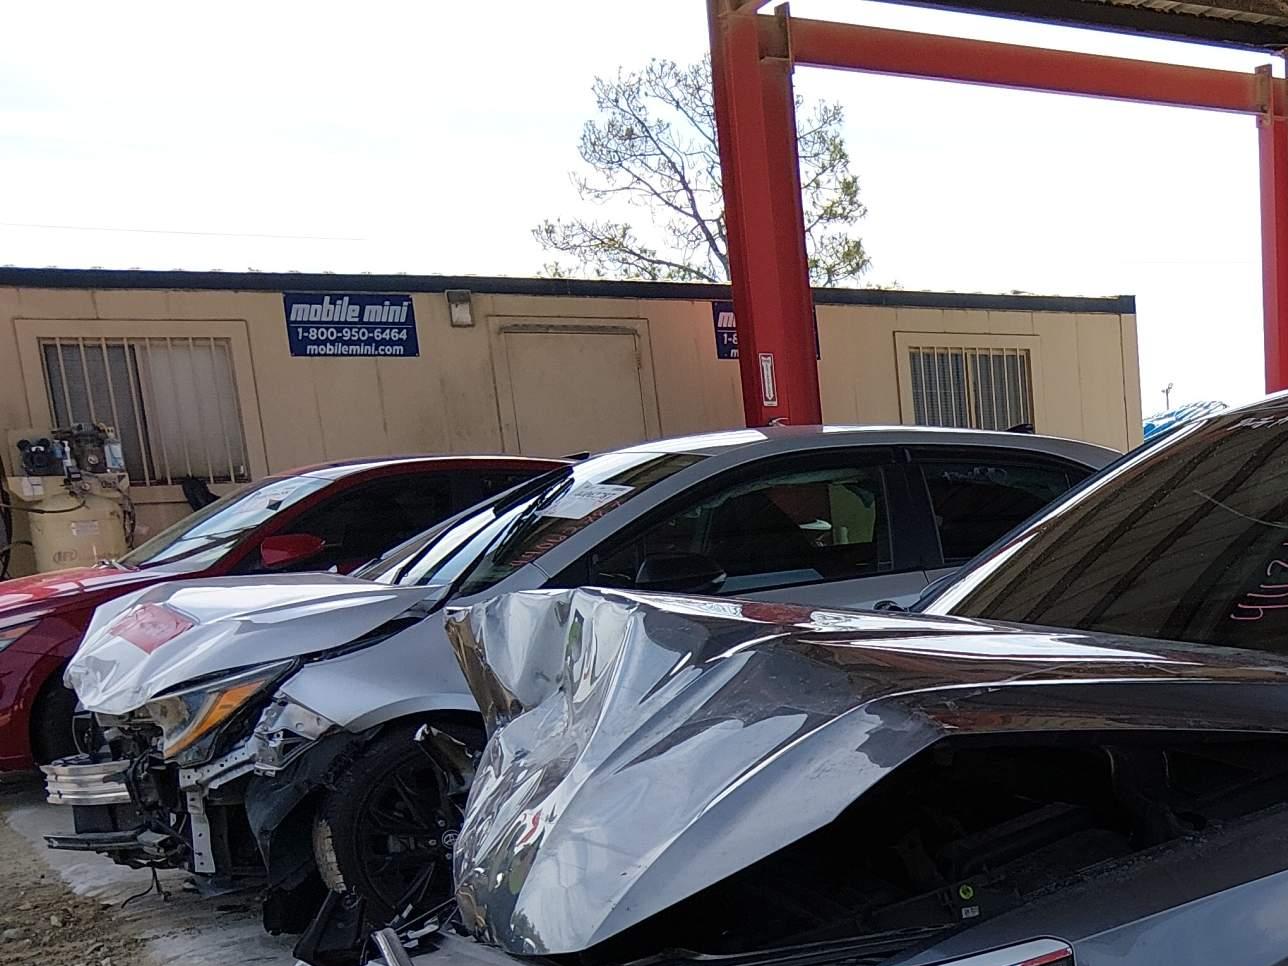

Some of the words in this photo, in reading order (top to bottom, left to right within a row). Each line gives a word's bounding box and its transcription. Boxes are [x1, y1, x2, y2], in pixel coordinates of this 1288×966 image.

[290, 296, 360, 321] mobile
[363, 301, 409, 322] mini
[297, 328, 407, 341] 1-800-950-6464
[306, 343, 404, 355] mobilemini.com
